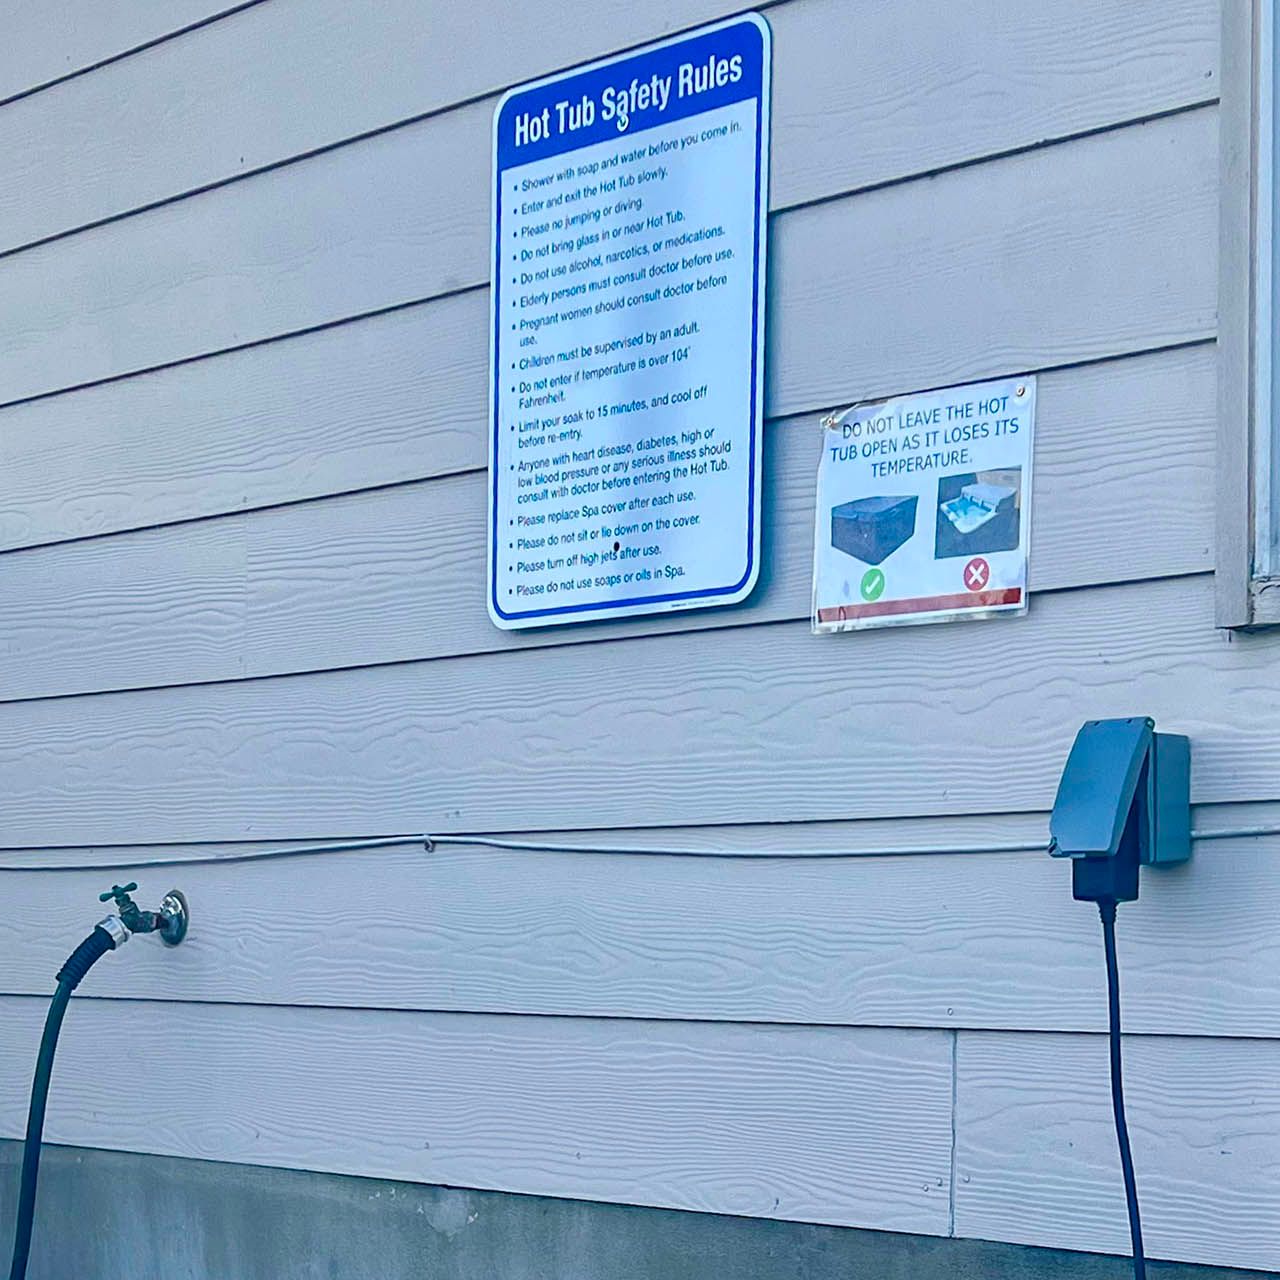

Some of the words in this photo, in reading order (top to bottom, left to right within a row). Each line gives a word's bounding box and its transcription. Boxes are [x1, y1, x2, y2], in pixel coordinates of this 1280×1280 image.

[515, 108, 549, 146] Hot
[555, 95, 594, 133] Tub
[601, 74, 671, 119] Safety
[678, 55, 741, 97] Rules
[521, 174, 554, 192] Shower
[556, 167, 575, 181] with
[576, 161, 599, 176] soap
[600, 153, 618, 169] and
[620, 148, 646, 164] water
[648, 139, 678, 156] before
[680, 133, 698, 150] you
[700, 125, 727, 142] come
[521, 200, 544, 215] Enter
[545, 192, 563, 208] and
[564, 188, 581, 203] exit
[583, 185, 597, 198] the
[599, 179, 615, 192] Hot
[618, 174, 635, 188] Tub
[520, 222, 549, 237] Please
[551, 219, 563, 229] no
[564, 208, 601, 229] jumping
[602, 205, 612, 216] or
[520, 249, 533, 262] Do
[535, 243, 549, 257] not
[551, 239, 574, 254] bring
[576, 233, 599, 250] glass
[601, 228, 610, 240] in
[611, 227, 621, 238] or
[623, 221, 644, 235] near
[646, 215, 663, 229] Hot
[519, 291, 549, 308] Elderly
[551, 283, 586, 303] persons
[588, 275, 610, 291] must
[613, 267, 646, 286] consult
[648, 261, 679, 278] doctor
[681, 253, 712, 269] before
[520, 272, 533, 285] Do
[534, 267, 549, 280] not
[550, 264, 566, 277] use
[652, 240, 662, 252] or
[519, 312, 558, 331] Pregnant
[560, 305, 592, 321] women
[594, 295, 625, 314] should
[626, 288, 660, 307] consult
[662, 282, 694, 298] doctor
[696, 275, 727, 291] before
[518, 354, 554, 370] Children
[556, 347, 578, 361] must
[580, 346, 592, 357] be
[594, 335, 643, 354] supervised
[645, 331, 657, 345] by
[659, 329, 671, 340] an
[519, 381, 531, 393] Do
[533, 377, 547, 390] not
[548, 374, 572, 388] enter
[574, 369, 580, 382] if
[582, 360, 636, 380] temperature
[637, 357, 646, 369] is
[648, 353, 668, 367] over
[518, 418, 539, 432] Limit
[541, 416, 560, 431] your
[562, 410, 583, 424] soak
[585, 408, 595, 420] to
[597, 404, 608, 417] 15
[650, 392, 668, 407] and
[670, 388, 691, 404] cool
[693, 384, 707, 399] off
[843, 422, 862, 439] DO
[866, 416, 894, 434] NOT
[899, 409, 940, 429] LEAVE
[945, 402, 974, 421] THE
[979, 396, 1009, 415] HOT
[517, 435, 545, 448] before
[517, 457, 550, 472] Anyone
[551, 452, 570, 465] with
[572, 447, 594, 461] heart
[681, 429, 701, 444] high
[703, 427, 715, 439] or
[831, 445, 857, 462] TUB
[862, 438, 897, 458] OPEN
[902, 435, 920, 450] AS
[925, 432, 939, 447] IT
[944, 423, 989, 444] LOSES
[995, 418, 1019, 435] ITS
[517, 477, 532, 487] low
[534, 470, 559, 485] blood
[560, 465, 599, 483] pressure
[600, 463, 611, 474] or
[612, 460, 629, 473] any
[631, 454, 664, 469] serious
[698, 439, 731, 457] should
[517, 488, 548, 504] consult
[550, 485, 568, 498] with
[570, 481, 600, 495] doctor
[601, 476, 631, 490] before
[632, 470, 670, 485] entering
[672, 466, 688, 478] the
[690, 461, 707, 475] Hot
[517, 514, 545, 526] Please
[547, 509, 579, 523] replace
[581, 504, 599, 518] Spa
[601, 501, 626, 514] cover
[628, 496, 650, 510] after
[651, 491, 674, 506] each
[517, 537, 545, 550] Please
[547, 534, 559, 545] do
[560, 531, 575, 543] not
[577, 528, 587, 541] sit
[589, 530, 599, 539] or
[601, 526, 612, 537] lie
[613, 523, 639, 536] down
[641, 521, 653, 532] on
[655, 517, 670, 530] the
[516, 561, 545, 573] Please
[546, 558, 564, 569] turn
[566, 553, 578, 566] off
[580, 552, 599, 566] high
[600, 549, 617, 564] jets
[619, 546, 640, 559] after
[516, 584, 544, 595] Please
[546, 580, 558, 592] do
[559, 578, 574, 590] not
[576, 577, 592, 589] use
[594, 574, 621, 587] soaps
[623, 572, 634, 583] or
[635, 568, 651, 581] oils
[653, 567, 662, 578] in
